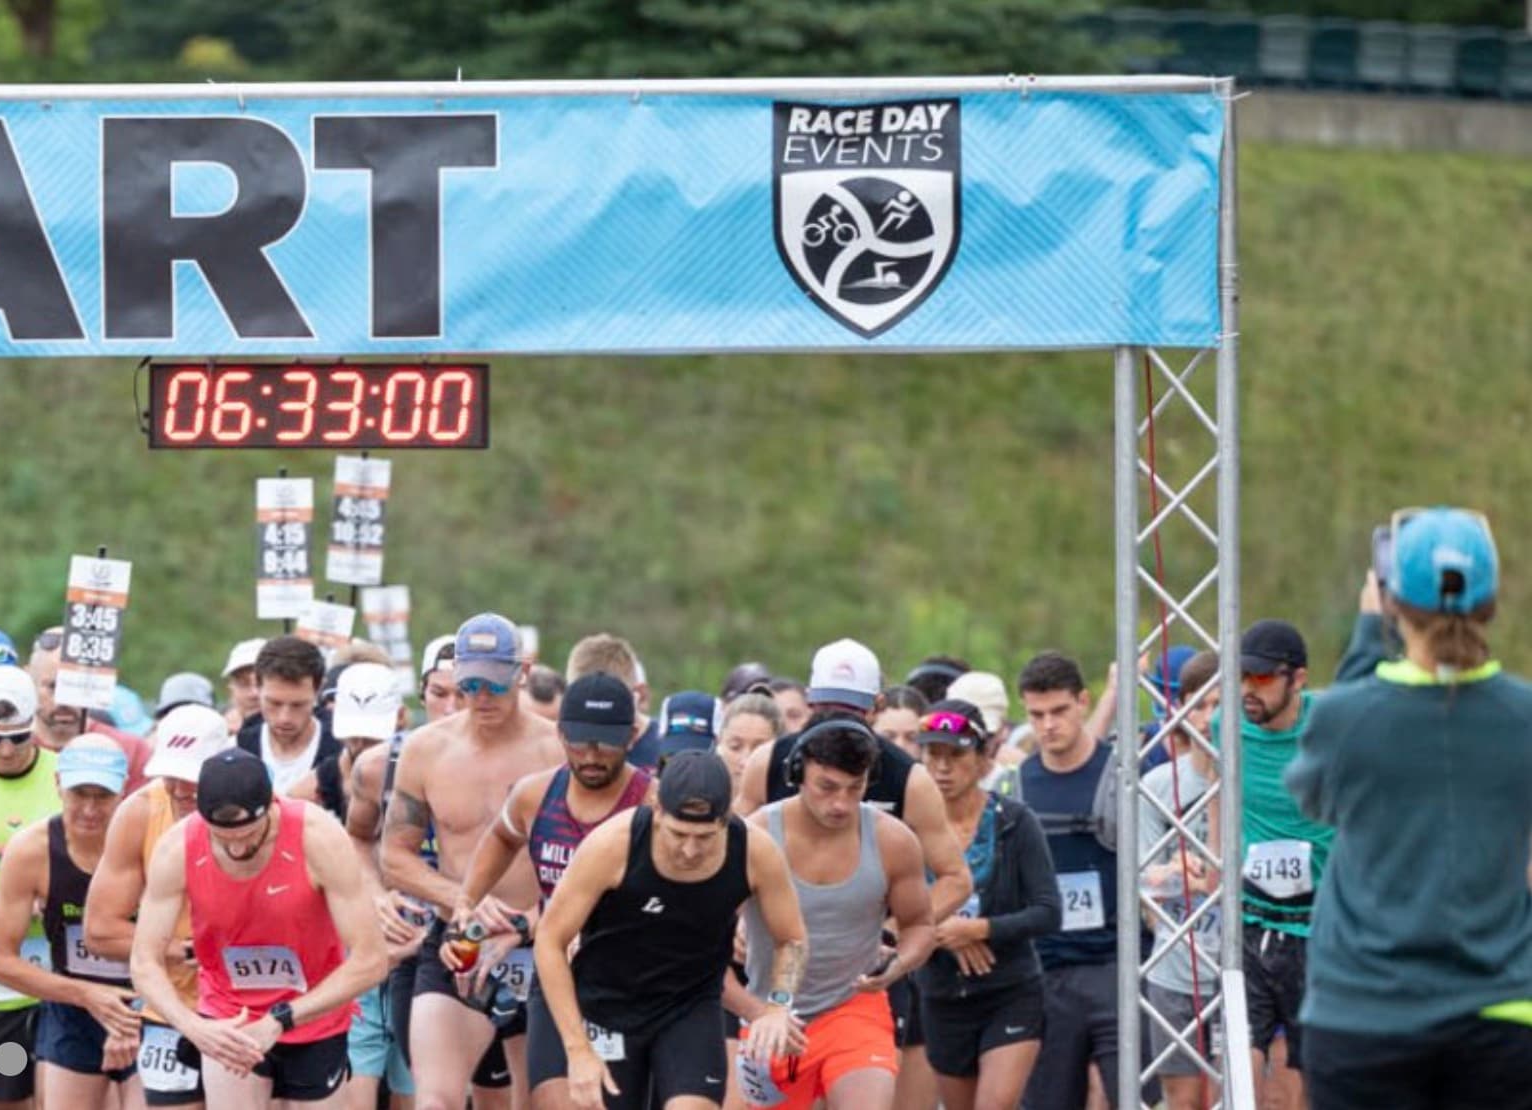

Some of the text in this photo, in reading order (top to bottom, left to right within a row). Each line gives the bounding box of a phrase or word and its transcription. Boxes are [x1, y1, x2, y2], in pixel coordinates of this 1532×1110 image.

[788, 104, 952, 136] RACE DAY
[783, 133, 944, 165] EVENTS
[163, 371, 473, 441] 06:33:00
[70, 603, 118, 632] 3:45
[66, 633, 115, 662] 8:35
[1249, 857, 1302, 880] 5143
[233, 958, 294, 977] 5174
[141, 1044, 188, 1076] 515
